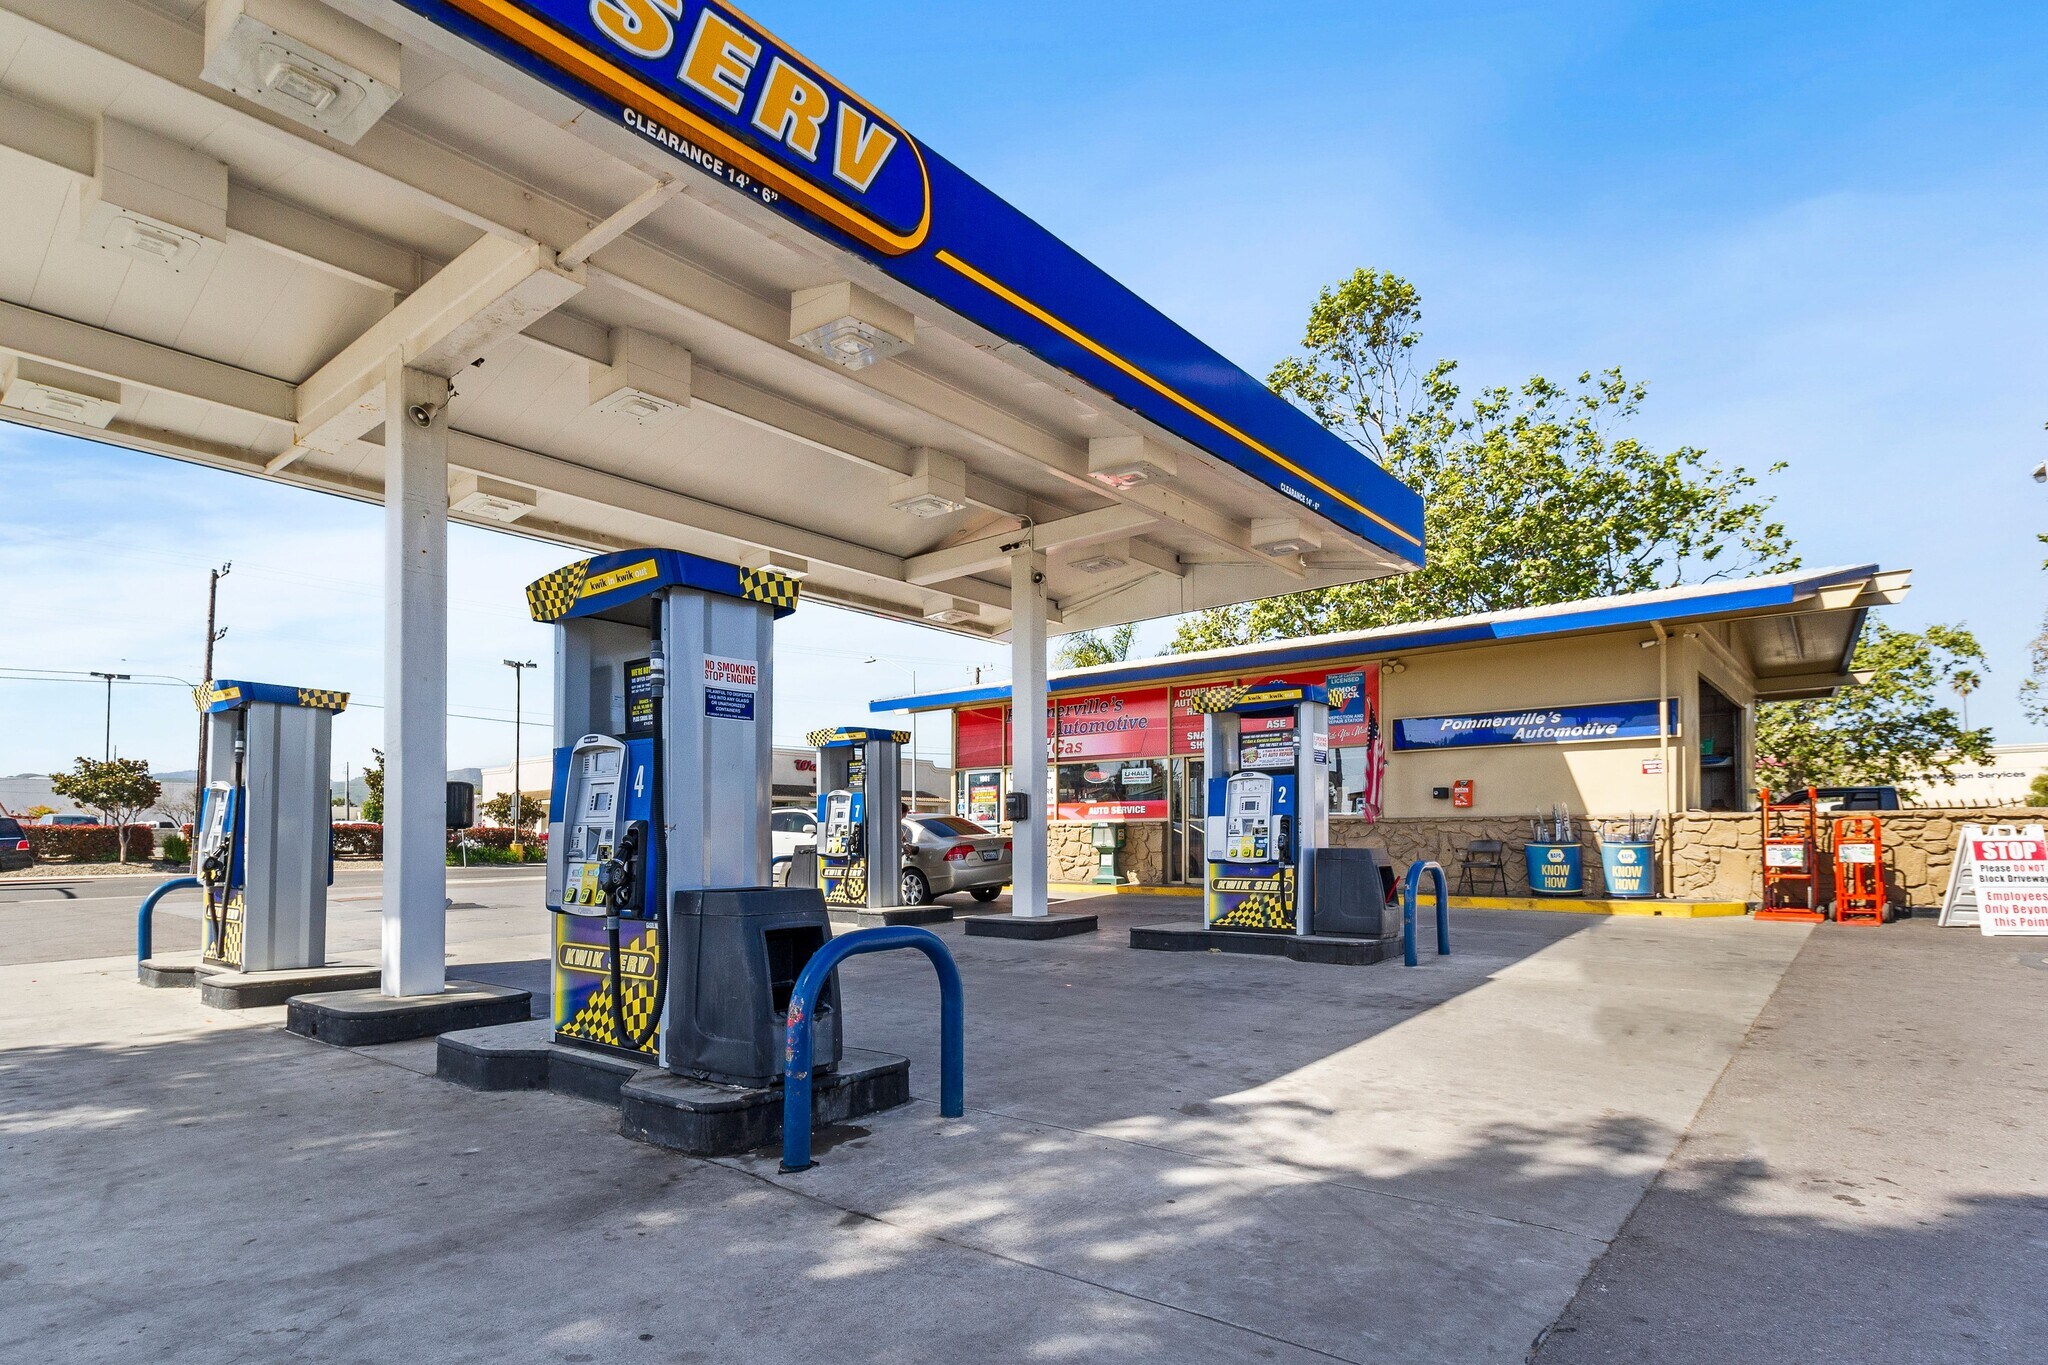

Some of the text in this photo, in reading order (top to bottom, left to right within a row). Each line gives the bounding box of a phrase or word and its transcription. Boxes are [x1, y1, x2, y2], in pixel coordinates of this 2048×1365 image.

[589, 0, 898, 193] SERV
[623, 107, 723, 177] CLEARANCE
[1280, 482, 1305, 503] CLEARANCE
[589, 578, 607, 591] kwik
[616, 570, 634, 583] kwik
[634, 566, 648, 577] out
[705, 659, 756, 675] NO SMOKING
[704, 669, 757, 685] STOP ENGINE
[1331, 676, 1360, 684] LICENSED
[1342, 690, 1360, 699] ECK
[1174, 698, 1192, 708] AUT
[715, 706, 741, 714] CONTAINERS
[1006, 696, 1123, 723] Pmerville's
[1051, 714, 1148, 736] Automotive
[1266, 719, 1287, 729] ASE
[1440, 711, 1562, 731] Pommerville's
[1187, 731, 1204, 740] SNA
[1513, 722, 1618, 740] Automotive
[1052, 738, 1083, 755] Gas
[1190, 740, 1204, 750] SH
[794, 759, 816, 771] Wa
[634, 765, 644, 798] 4
[1977, 771, 2027, 780] Services
[1278, 786, 1287, 803] 2
[1088, 805, 1146, 816] AUTO SERVICE
[1981, 841, 2038, 860] STOP
[824, 869, 842, 877] KWIK
[1541, 864, 1570, 876] KNOW
[1611, 865, 1643, 877] KNOW
[1980, 864, 2045, 872] Please DO NOT
[1544, 877, 1568, 888] HOW
[1614, 878, 1640, 891] HOW
[1979, 874, 2005, 883] Block
[1216, 880, 1252, 890] KWIK
[1985, 904, 2048, 915] Only Beyon
[1994, 917, 2017, 927] this
[564, 947, 605, 969] KWIK
